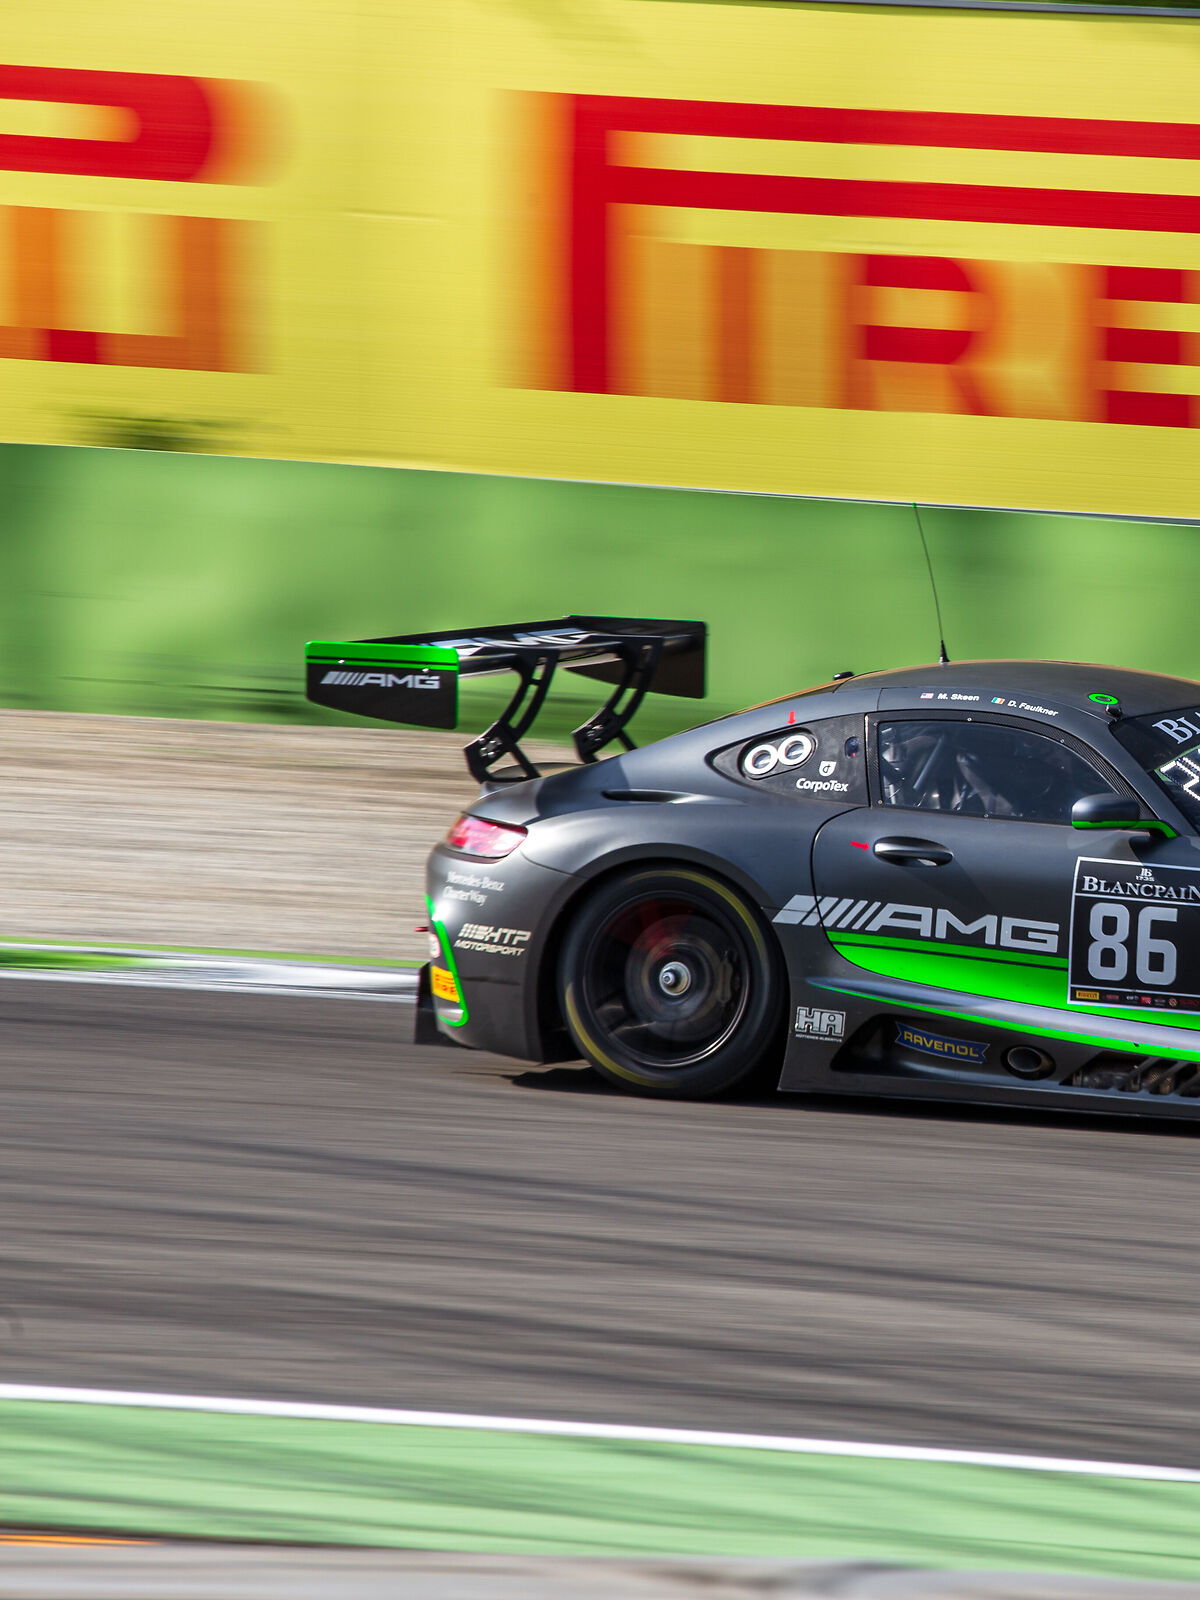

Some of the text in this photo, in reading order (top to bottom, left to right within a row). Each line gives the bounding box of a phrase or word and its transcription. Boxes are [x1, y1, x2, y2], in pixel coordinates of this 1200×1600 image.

[357, 672, 441, 690] AMG
[796, 778, 849, 793] CorpoTex
[864, 902, 1060, 954] AMG
[453, 939, 527, 957] MOTORSPORT
[1087, 902, 1179, 986] 86
[902, 1030, 979, 1058] RAVENOL
